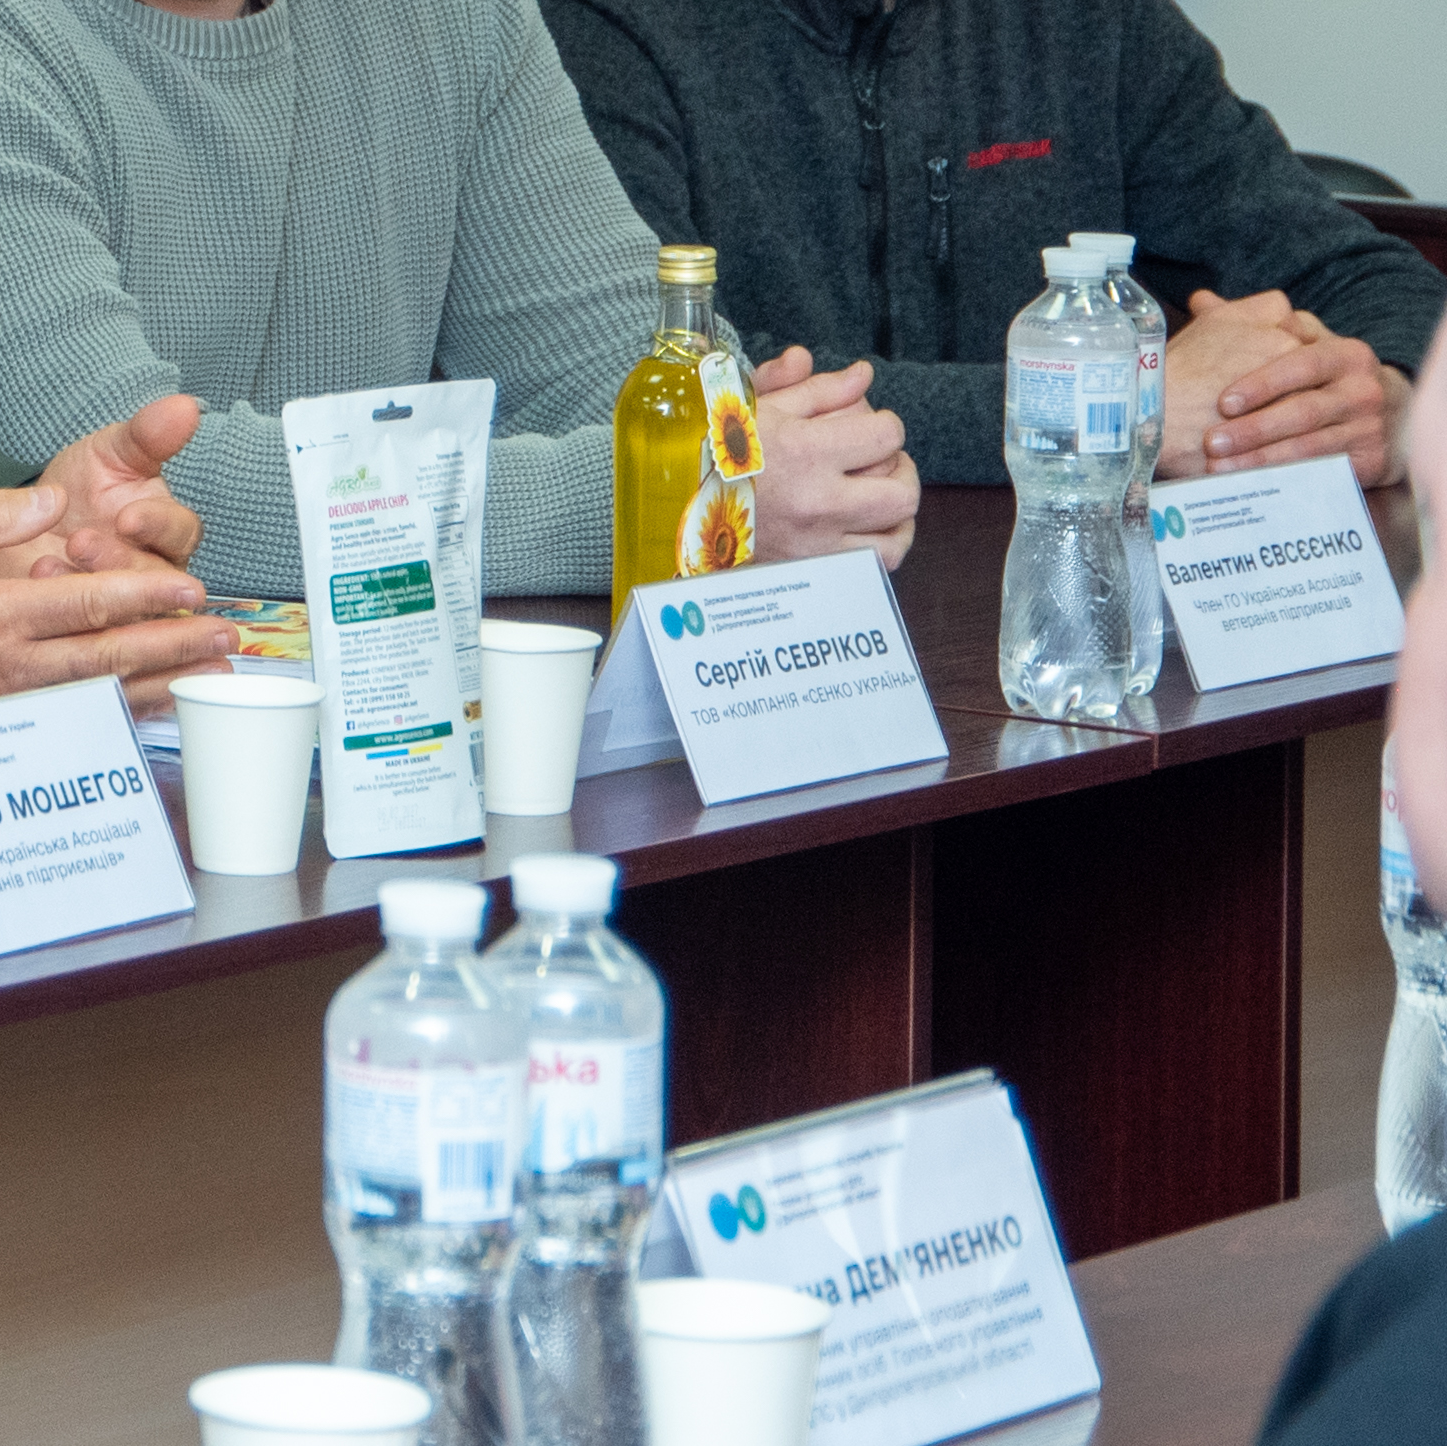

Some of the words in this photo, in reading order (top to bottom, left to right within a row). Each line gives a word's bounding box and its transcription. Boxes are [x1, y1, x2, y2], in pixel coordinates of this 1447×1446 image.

[1019, 358, 1076, 372] morshynska
[328, 500, 368, 519] DELICIOUS
[367, 497, 389, 511] APPLE
[387, 494, 410, 509] CHIPS
[1165, 553, 1258, 586] Валентин
[1258, 528, 1363, 568] ЄВСЄЄНКО
[1193, 599, 1224, 613] Член
[1222, 592, 1241, 608] ГО
[1240, 583, 1307, 606] Українська
[1307, 569, 1365, 593] Асоціація
[1221, 610, 1279, 633] ветеранів
[1278, 595, 1353, 621] підприємців
[694, 648, 772, 690] Сергій
[774, 629, 889, 673] СЕВРІКОВ
[690, 706, 721, 726] ТОВ
[722, 691, 800, 719] «КОМПАНІЯ
[801, 681, 853, 705] «СЕНКО
[852, 670, 917, 696] УКРАЇНА»
[5, 766, 144, 820] МОШЕГОВ
[71, 819, 142, 849] Асоціація
[26, 851, 125, 885] підприємців»
[844, 1214, 1022, 1306] ДЕМ'ЯНЕНКО
